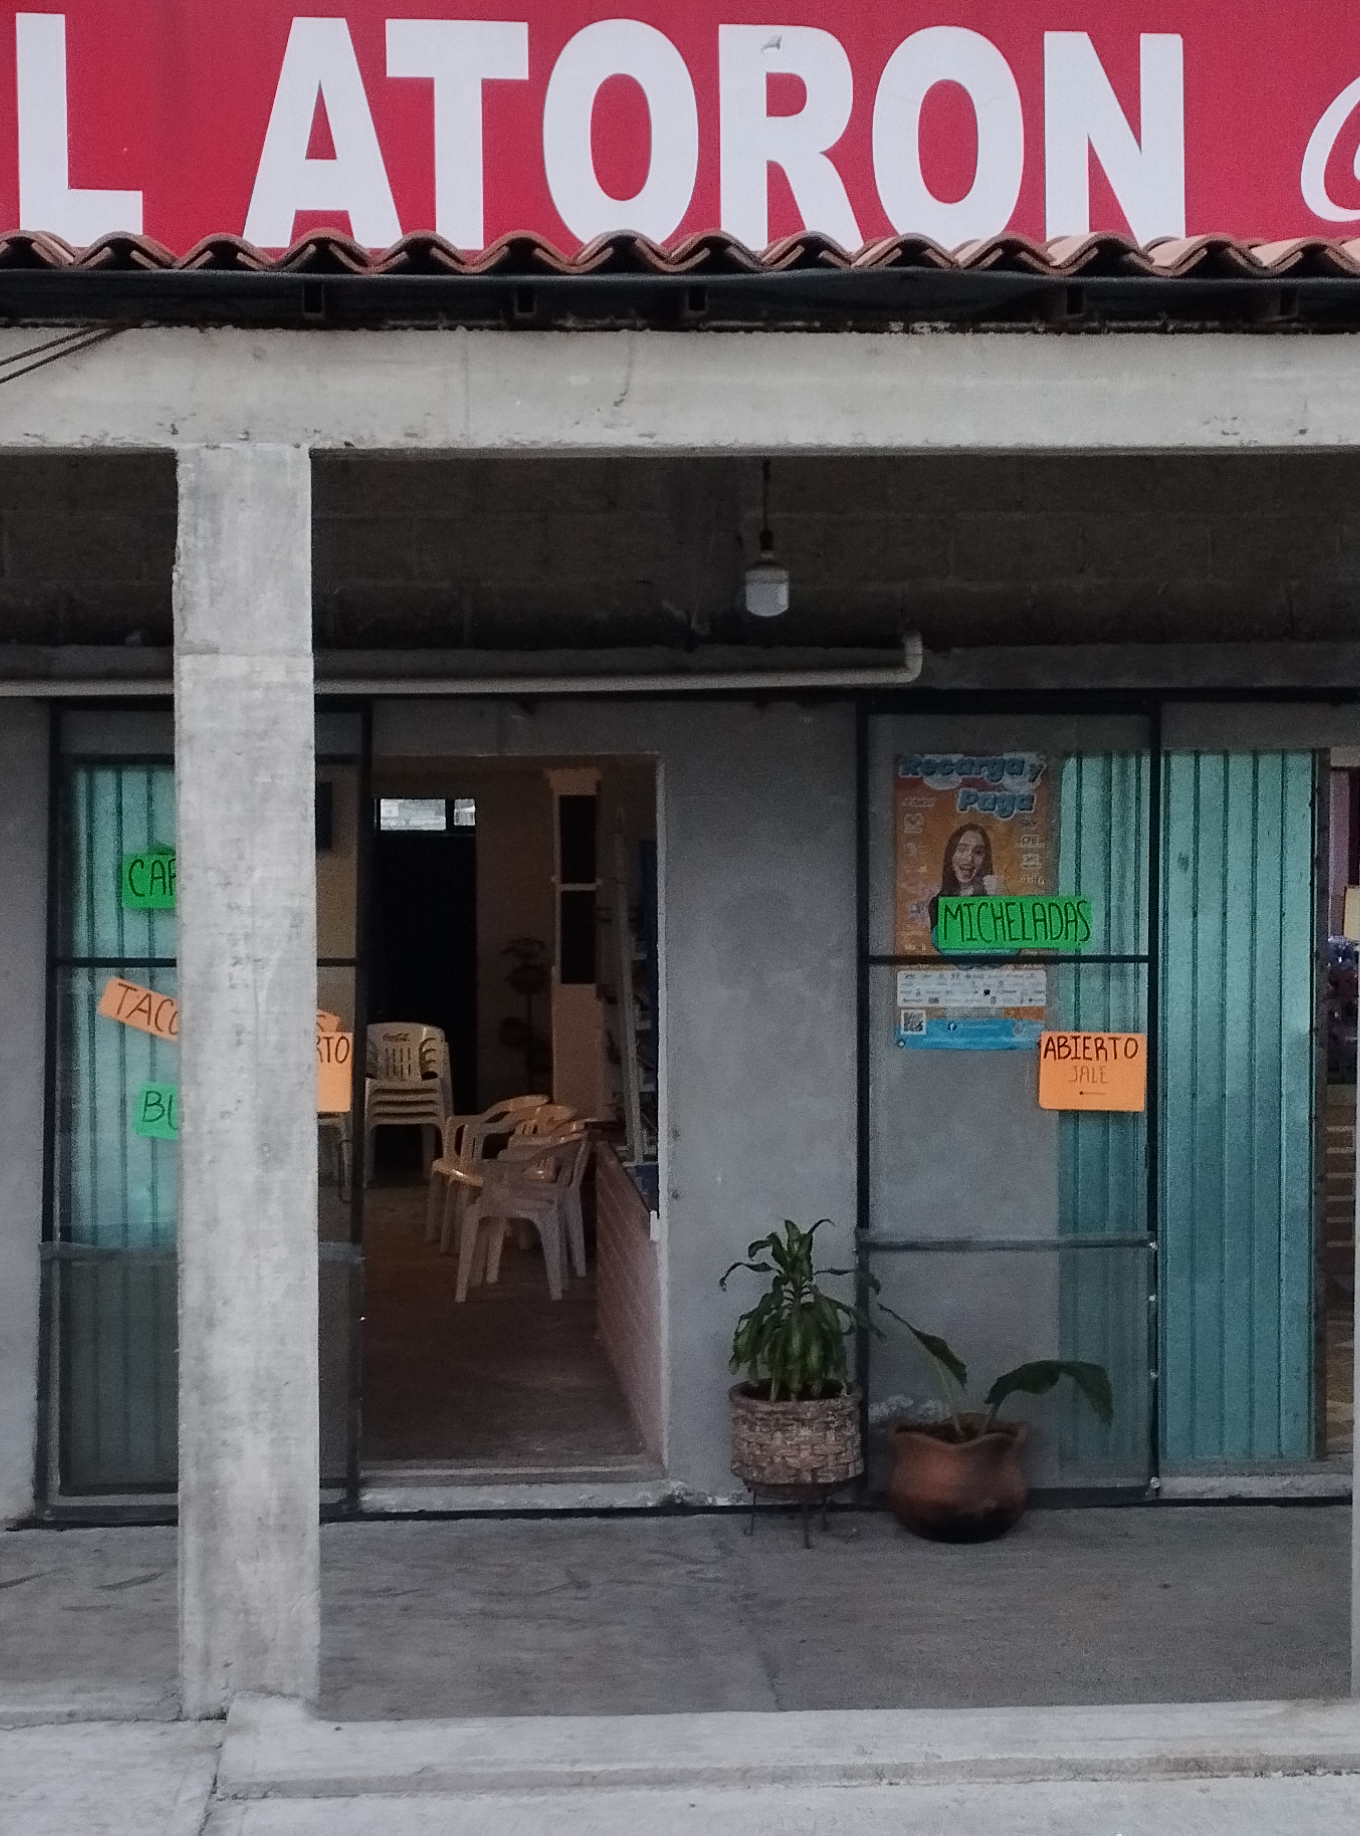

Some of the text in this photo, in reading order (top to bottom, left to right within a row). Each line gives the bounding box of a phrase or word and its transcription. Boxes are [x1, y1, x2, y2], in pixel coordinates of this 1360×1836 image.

[242, 16, 1184, 251] ATORON
[944, 900, 1090, 942] MICHELADAS
[1043, 1036, 1139, 1061] ABIERTO
